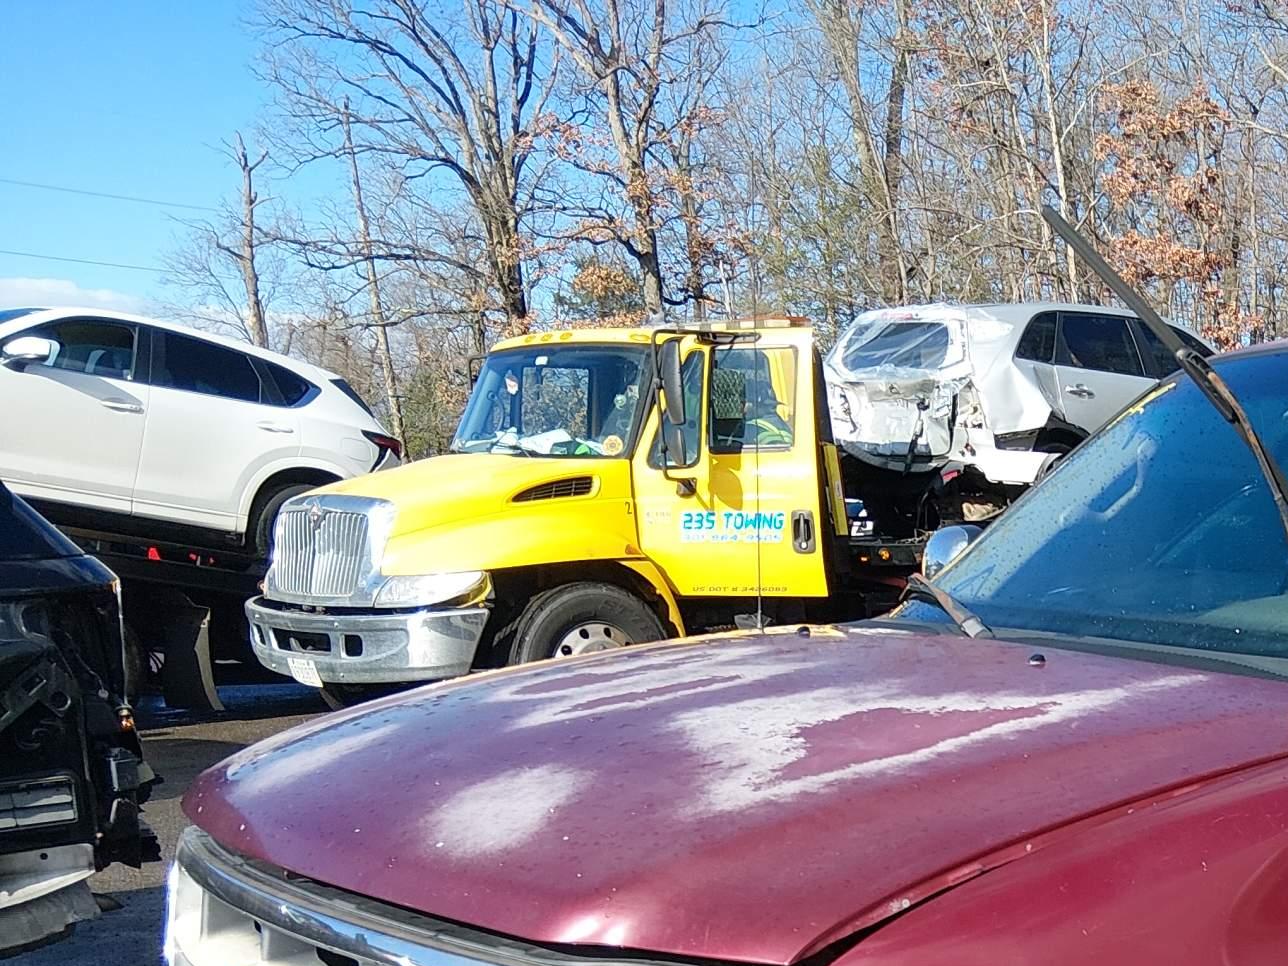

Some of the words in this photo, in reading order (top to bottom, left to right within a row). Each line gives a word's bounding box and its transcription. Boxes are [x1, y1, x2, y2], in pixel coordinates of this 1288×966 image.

[624, 501, 633, 515] 2
[682, 511, 716, 529] 235
[723, 512, 785, 530] TOWING
